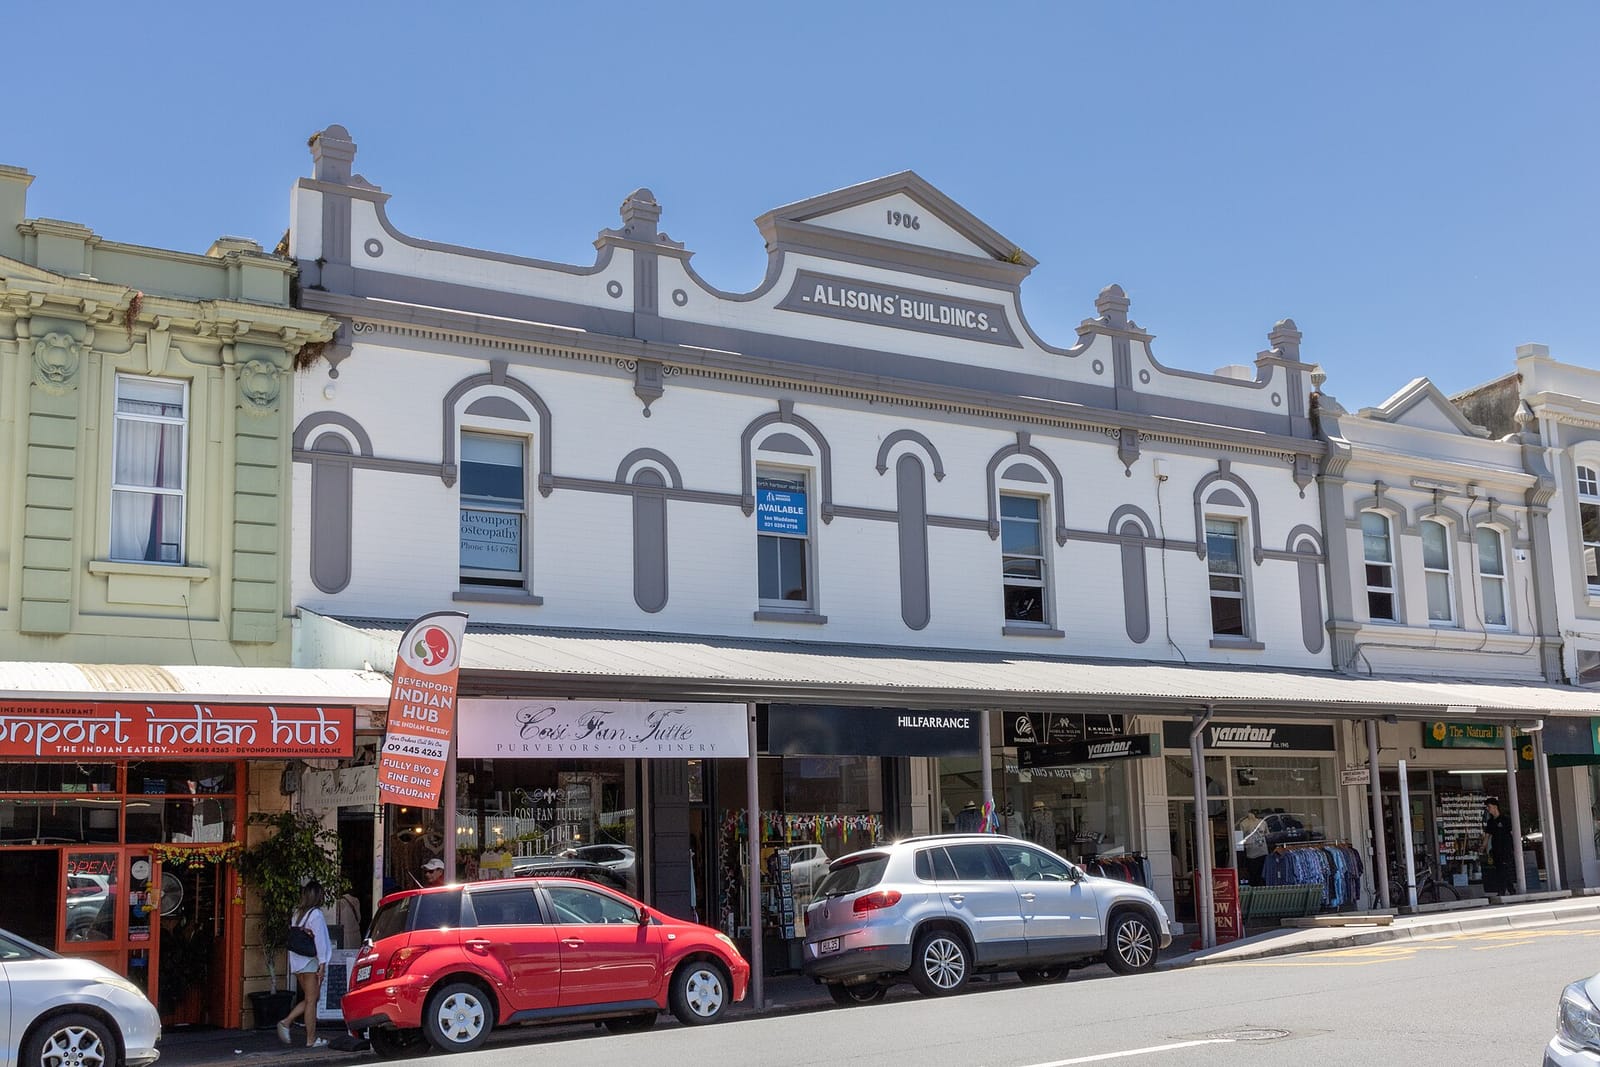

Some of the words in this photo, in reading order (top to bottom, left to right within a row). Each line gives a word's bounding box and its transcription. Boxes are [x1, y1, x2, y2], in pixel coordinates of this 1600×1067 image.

[887, 210, 920, 231] 1906
[814, 284, 899, 314] ALISONS'
[758, 503, 804, 515] AVAILABLE
[461, 511, 518, 527] devonport
[461, 526, 518, 541] osteopathy
[461, 541, 484, 551] Phone
[398, 676, 454, 693] DEVENPORT
[394, 686, 453, 709] INDIAN
[39, 707, 94, 715] RESTAURANT
[403, 704, 439, 723] HUB
[401, 721, 425, 731] INDIAN
[426, 725, 450, 736] EATERY
[575, 708, 626, 740] Fan
[629, 708, 694, 743] Tutte
[898, 716, 970, 729] HILLFARRANCE
[0, 710, 132, 757] onport
[145, 704, 258, 745] indian
[268, 705, 340, 745] hub
[1211, 724, 1276, 747] yarntons
[1450, 726, 1463, 737] The
[1467, 726, 1493, 738] Natural
[56, 745, 77, 753] THE
[387, 743, 401, 752] 09
[402, 744, 419, 754] 445
[421, 747, 442, 758] 4263
[497, 743, 600, 752] PURVEYORS
[618, 744, 638, 752] OF
[658, 743, 717, 752] FINERY
[1088, 740, 1132, 759] yarntons
[383, 758, 412, 770] FULLY
[413, 764, 431, 775] BYO
[432, 768, 439, 776] &
[387, 771, 409, 783] FINE
[410, 776, 431, 788] DINE
[378, 782, 437, 801] RESTAURANT
[514, 808, 534, 820] COSI
[537, 808, 553, 820] FAN
[556, 808, 582, 820] TUTTE
[67, 860, 116, 874] OPEN
[1213, 902, 1230, 914] OW
[1214, 916, 1233, 928] PEN
